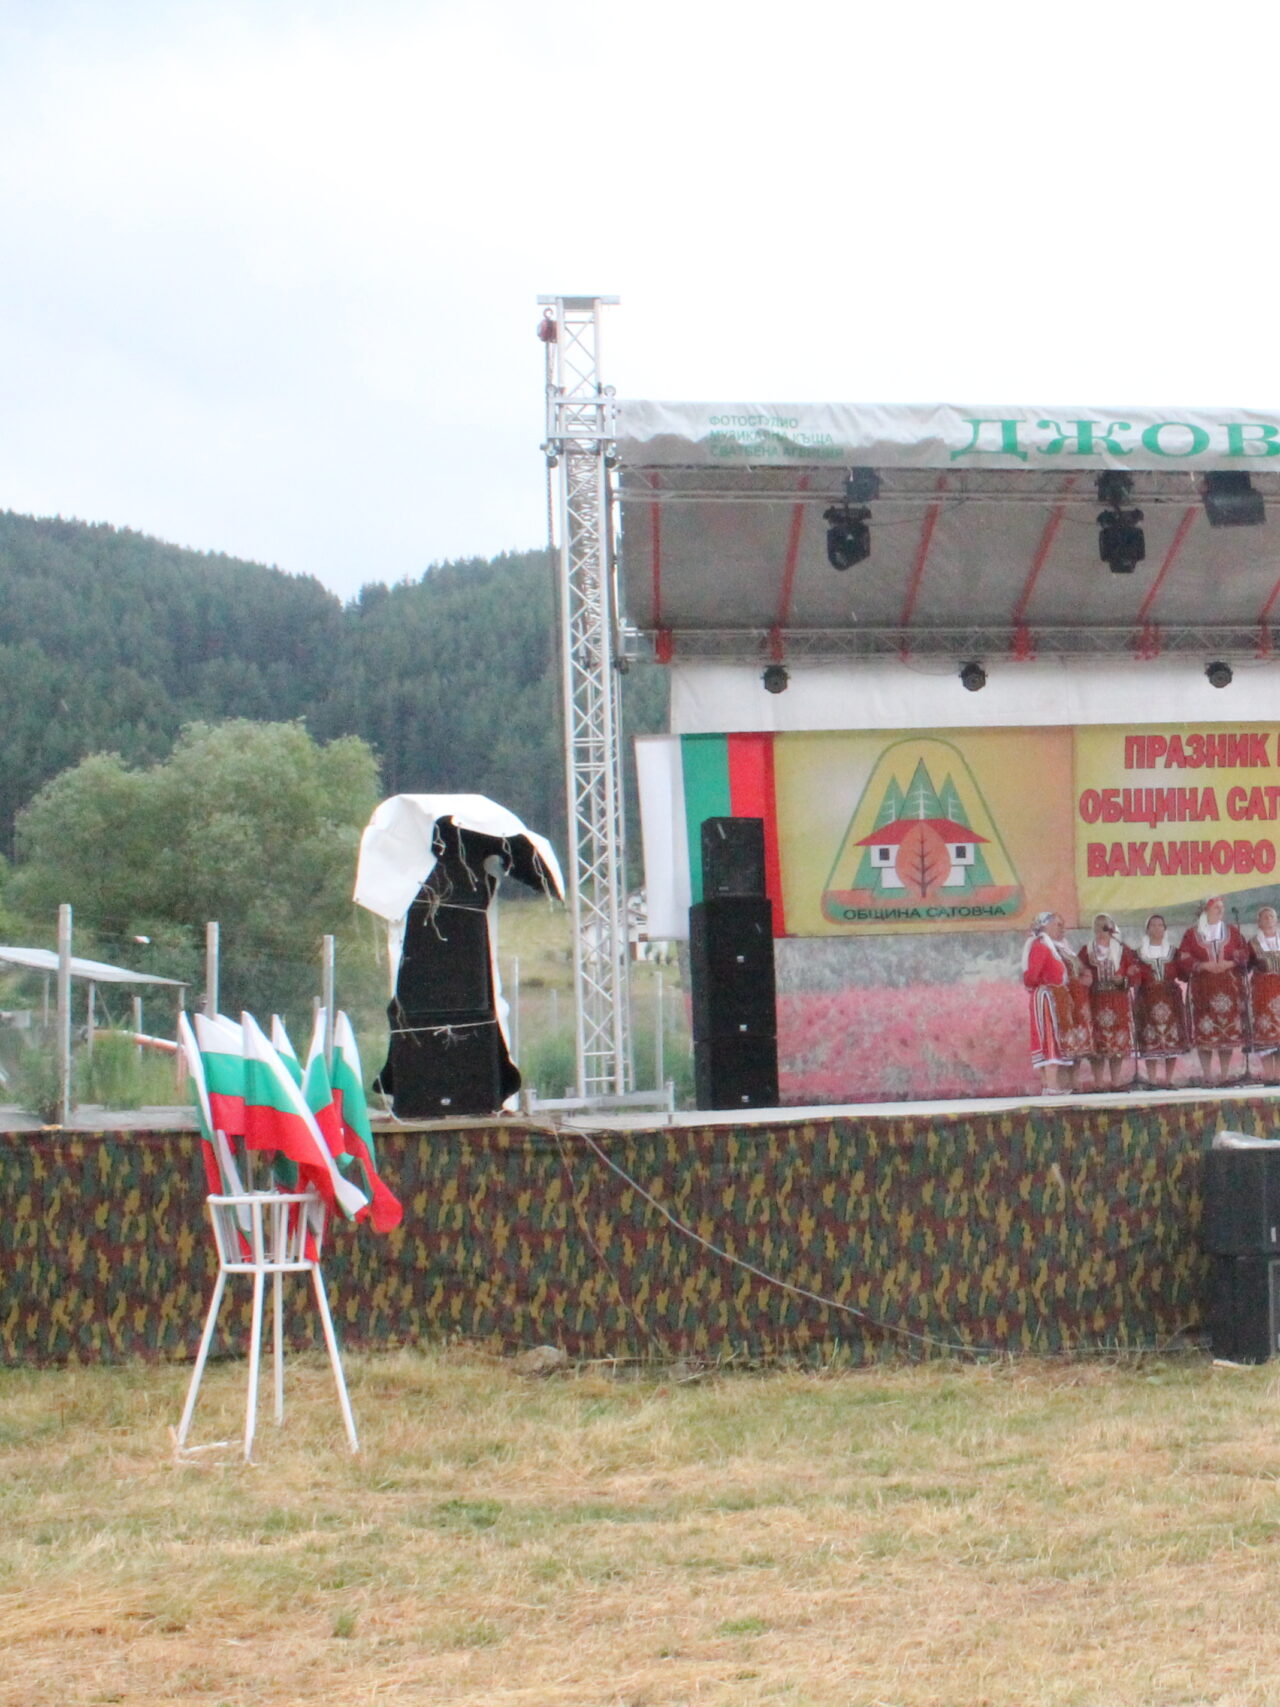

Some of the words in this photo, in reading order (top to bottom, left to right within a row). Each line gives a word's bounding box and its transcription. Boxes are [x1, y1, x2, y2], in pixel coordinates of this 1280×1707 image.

[1124, 733, 1271, 769] ПРАЗНИК
[1078, 786, 1220, 828] ОБЩИНА
[1087, 839, 1276, 878] ВАКЛИНОВО
[843, 907, 921, 921] ОБЩИНА
[926, 905, 1006, 919] САТОВЧА
